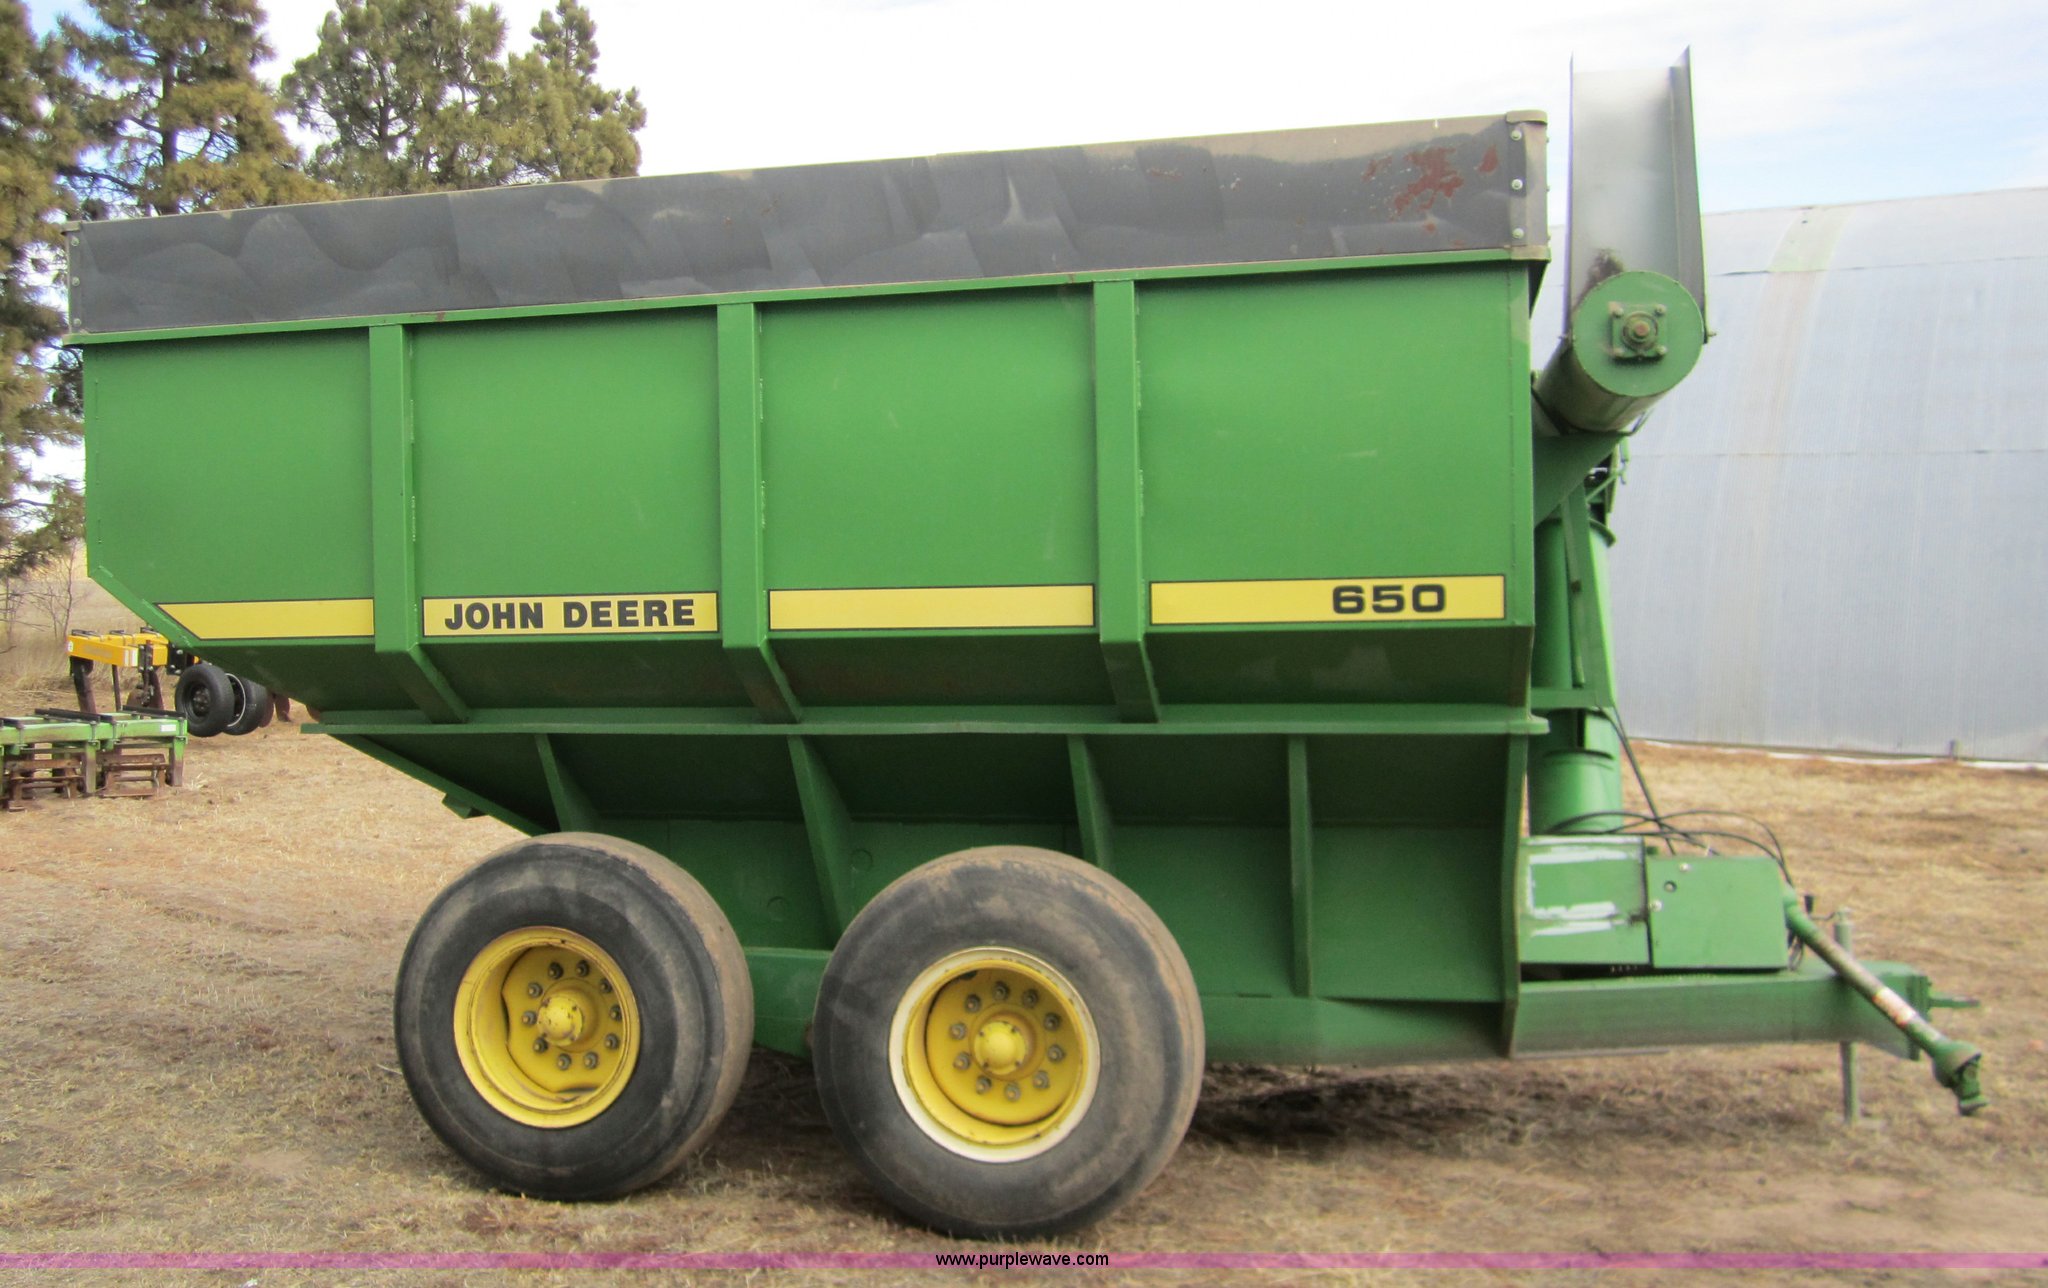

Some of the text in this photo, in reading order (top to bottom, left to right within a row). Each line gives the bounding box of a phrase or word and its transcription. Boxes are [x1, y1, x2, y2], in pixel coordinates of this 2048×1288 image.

[1332, 584, 1446, 614] 650
[444, 599, 695, 630] JOHN DEERE
